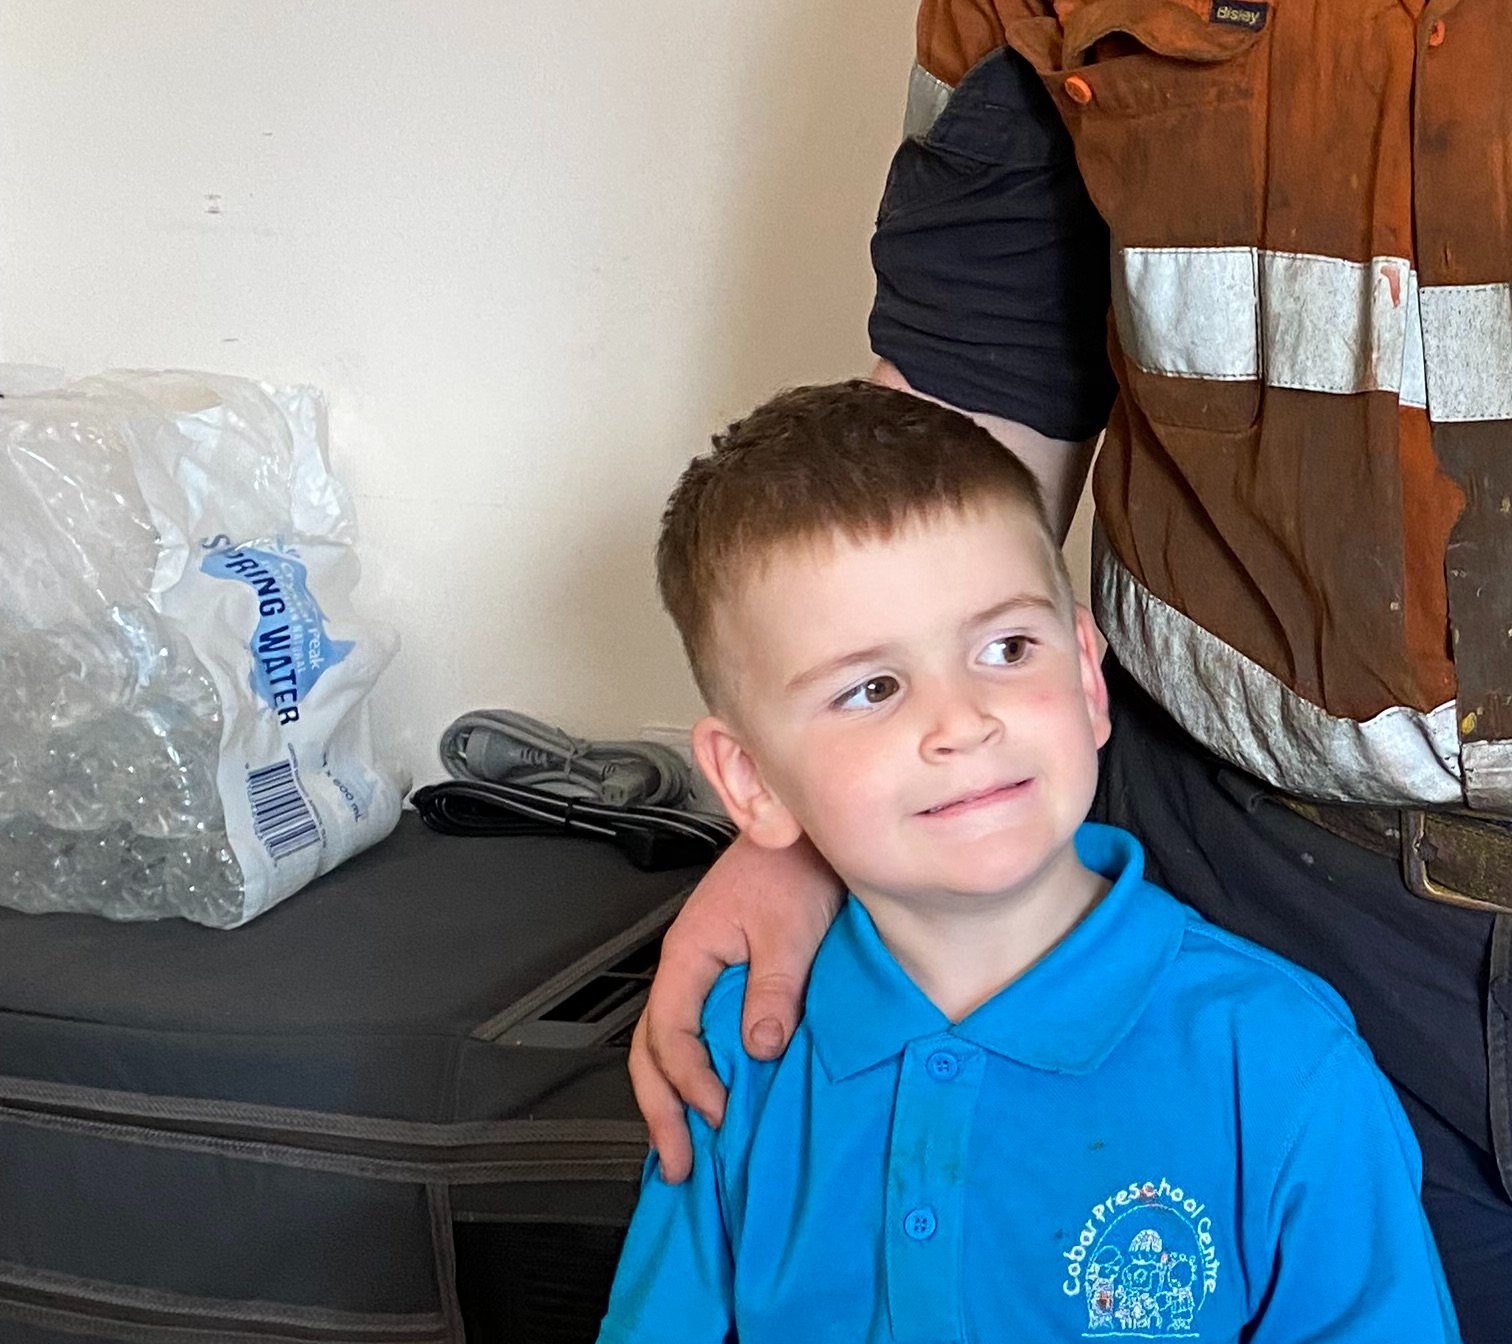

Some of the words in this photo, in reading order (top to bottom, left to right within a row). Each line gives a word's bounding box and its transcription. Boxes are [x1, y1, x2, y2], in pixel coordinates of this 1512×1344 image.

[257, 624, 300, 726] WATER
[1062, 1218, 1097, 1296] Cobar
[1091, 1176, 1206, 1224] Preschool
[1197, 1216, 1221, 1294] Centre
